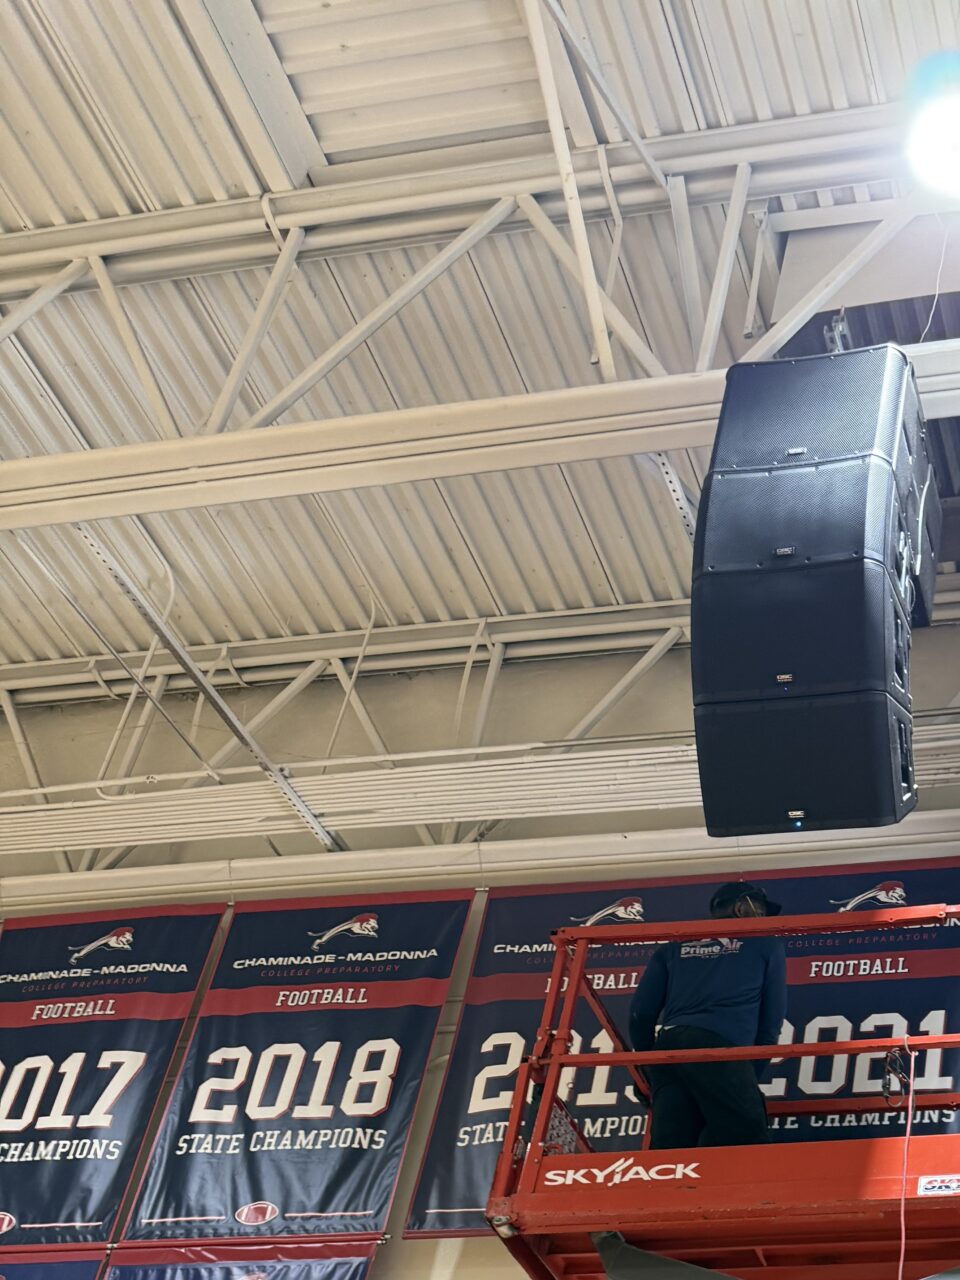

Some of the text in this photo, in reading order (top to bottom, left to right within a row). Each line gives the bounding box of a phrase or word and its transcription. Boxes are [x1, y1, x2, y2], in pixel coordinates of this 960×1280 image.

[680, 945, 721, 955] Prime
[722, 939, 744, 951] Air
[787, 932, 938, 948] COLLEGE PREPARATORY
[233, 949, 438, 969] CHAMINADE-MADONNA
[809, 957, 909, 977] FOOTBALL
[0, 963, 188, 983] CHAMINADE-MADONNA
[261, 964, 401, 977] COLLEGE PREPARATORY
[22, 976, 150, 993] COLLEGE PREPARATORY
[276, 988, 368, 1006] FOOTBALL
[31, 1000, 116, 1020] FOOTBALL
[188, 1038, 401, 1123] 2018
[0, 1050, 147, 1134] 017
[176, 1127, 388, 1155] STATE CHAMPIONS
[544, 1157, 701, 1186] SKYJACK
